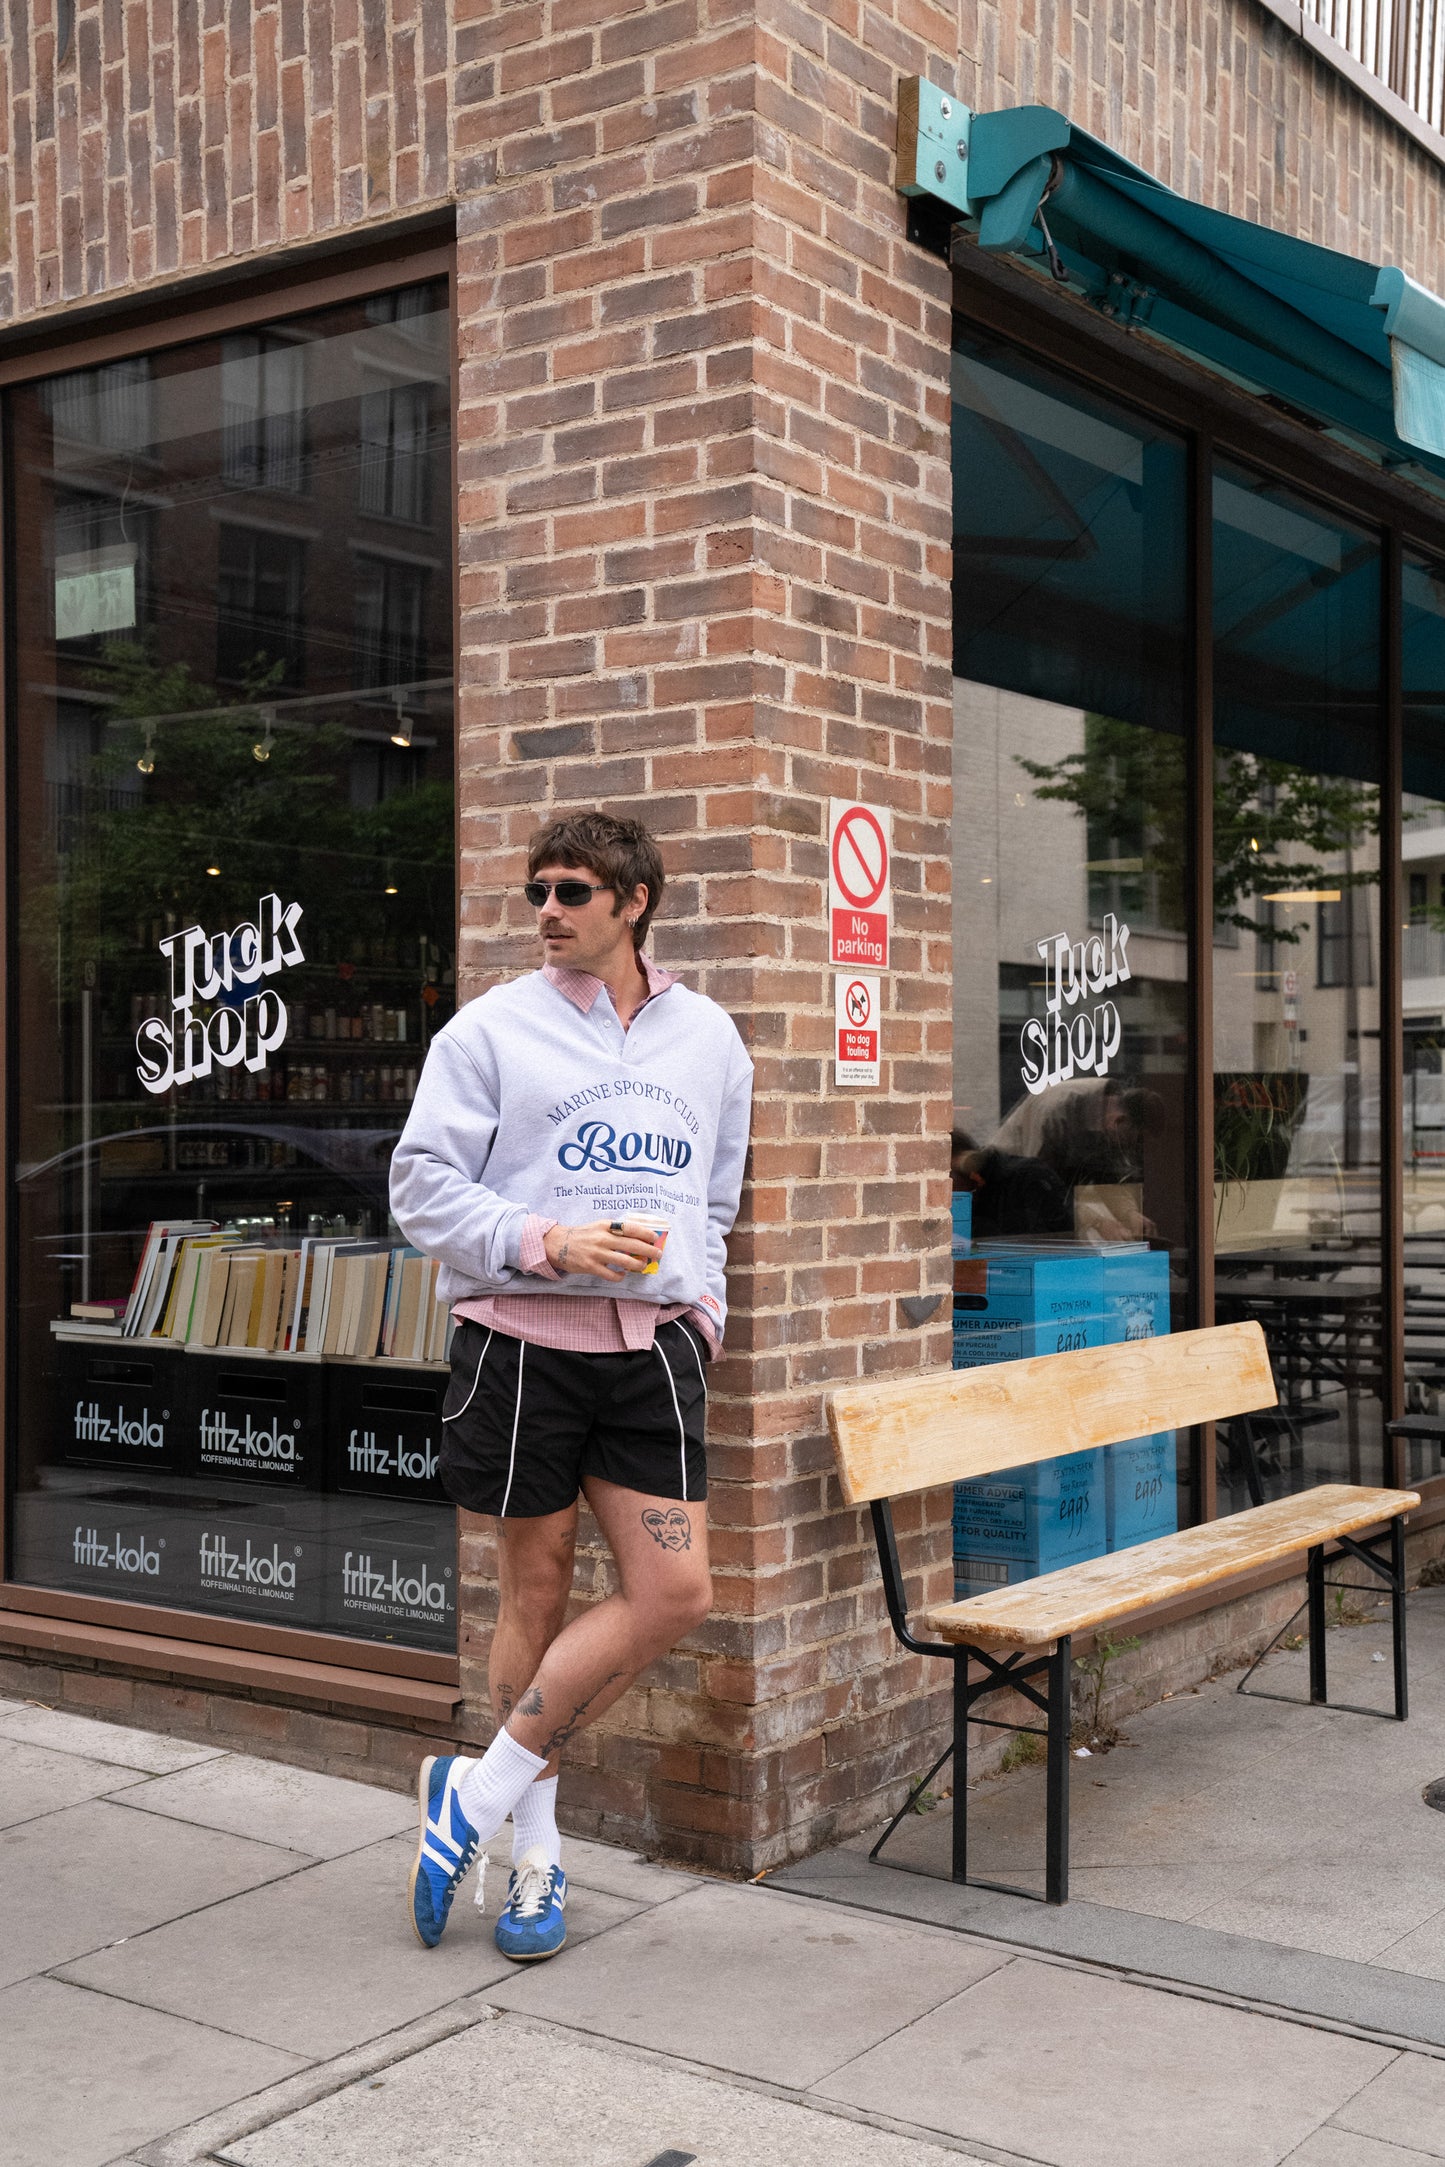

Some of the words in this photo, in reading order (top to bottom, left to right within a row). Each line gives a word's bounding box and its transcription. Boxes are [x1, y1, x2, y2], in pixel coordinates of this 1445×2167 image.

[852, 917, 868, 935] No
[159, 893, 305, 1006] Tuck
[837, 938, 882, 961] parking
[1037, 913, 1131, 1012] Tuck
[846, 1033, 856, 1044] No
[857, 1034, 870, 1047] dog
[847, 1046, 869, 1059] fouling
[547, 1083, 611, 1126] MARINE
[613, 1080, 672, 1105] SPORTS
[673, 1097, 700, 1135] CLUB
[554, 1185, 573, 1197] The
[575, 1184, 613, 1196] Nautical
[616, 1184, 654, 1195] Division
[593, 1199, 648, 1210] DESIGNED
[650, 1199, 661, 1210] IN
[984, 1321, 1021, 1330] ADVICE
[74, 1401, 164, 1447] fritz-kola
[200, 1409, 294, 1460] fritz-kola
[201, 1453, 257, 1468] KOFFEINHALTIGE
[258, 1460, 294, 1472] LIMONADE
[987, 1488, 1024, 1499] ADVICE
[1135, 1474, 1163, 1520] eggs
[1059, 1490, 1089, 1539] eggs
[961, 1526, 980, 1536] FOR
[983, 1529, 1027, 1541] QUALITY
[73, 1526, 160, 1575] fritz-kola
[200, 1532, 295, 1588] fritz-kola
[201, 1579, 257, 1595] KOFFEINHALTIGE
[258, 1587, 294, 1600] LIMONADE
[342, 1552, 445, 1610] fritz-kola
[343, 1599, 404, 1616] KOFFEINHALTIGE
[405, 1608, 445, 1622] LIMONADE
